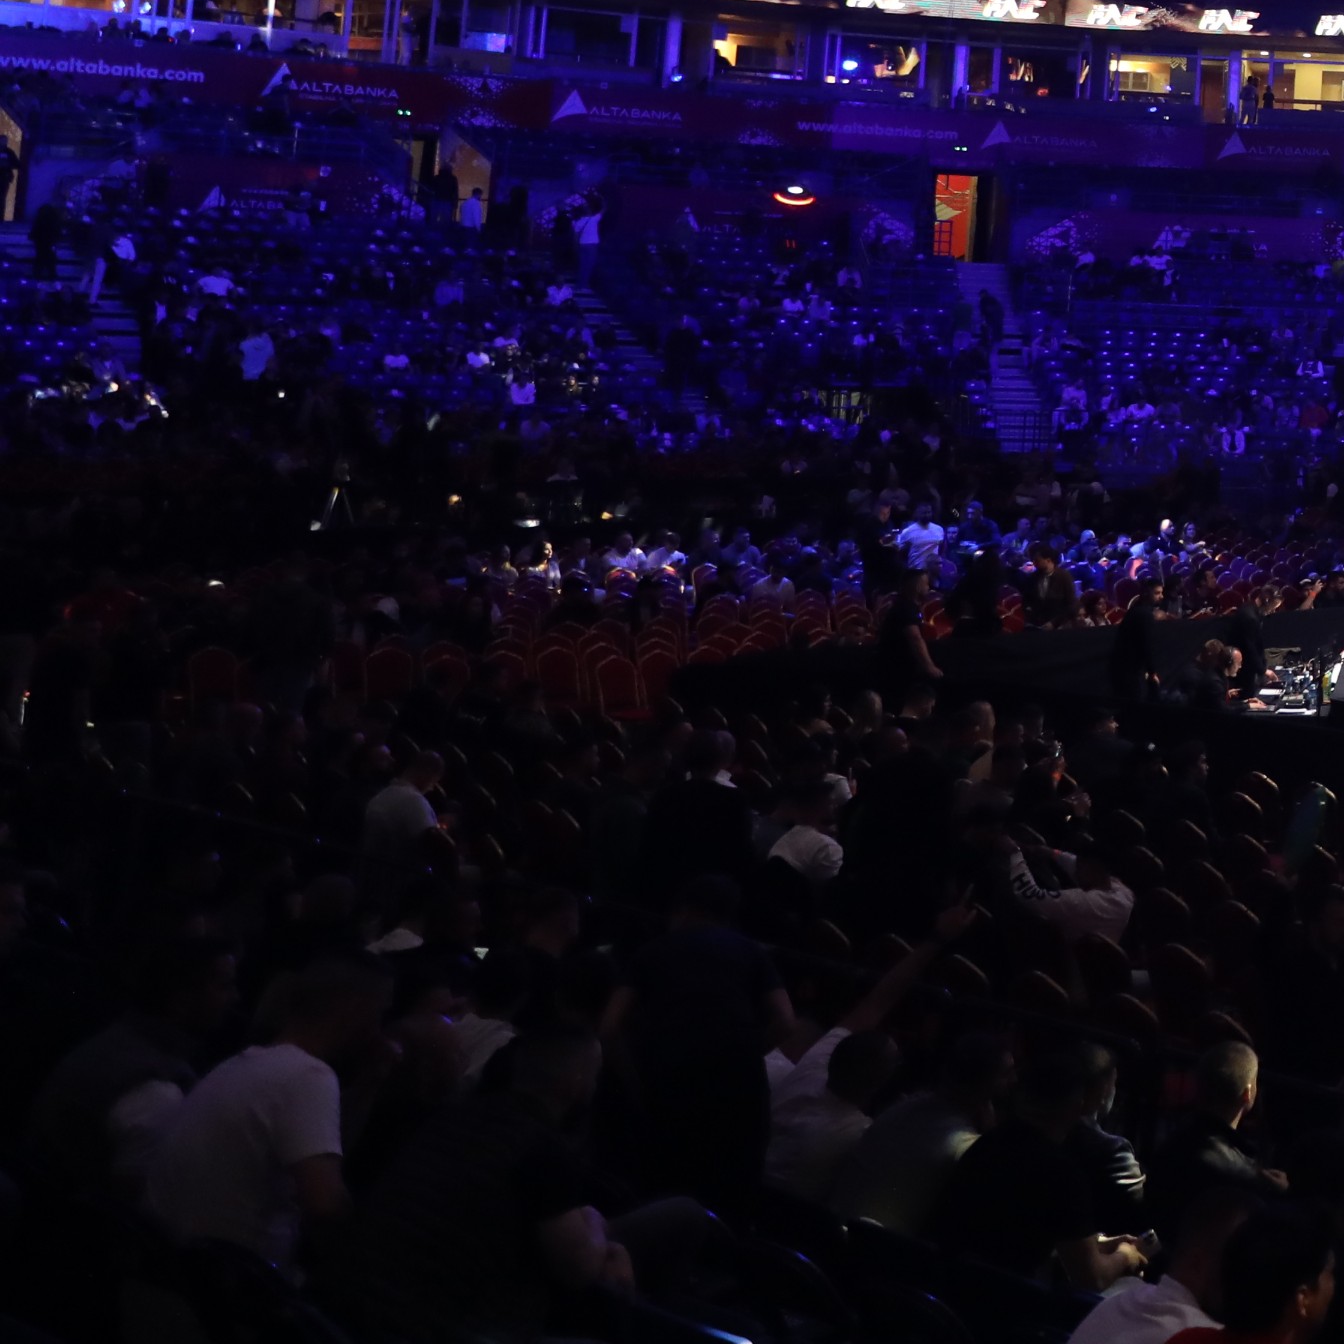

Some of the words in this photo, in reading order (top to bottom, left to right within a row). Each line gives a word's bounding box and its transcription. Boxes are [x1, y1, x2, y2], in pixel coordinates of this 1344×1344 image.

[1087, 3, 1149, 28] FNC
[1198, 9, 1261, 34] FNC
[301, 81, 401, 100] ALTABANKA
[589, 106, 683, 123] ALTABANKA
[797, 120, 960, 141] www.altabanka.com
[1014, 135, 1098, 149] ALTABANKA
[1249, 145, 1332, 158] ALTABANKA
